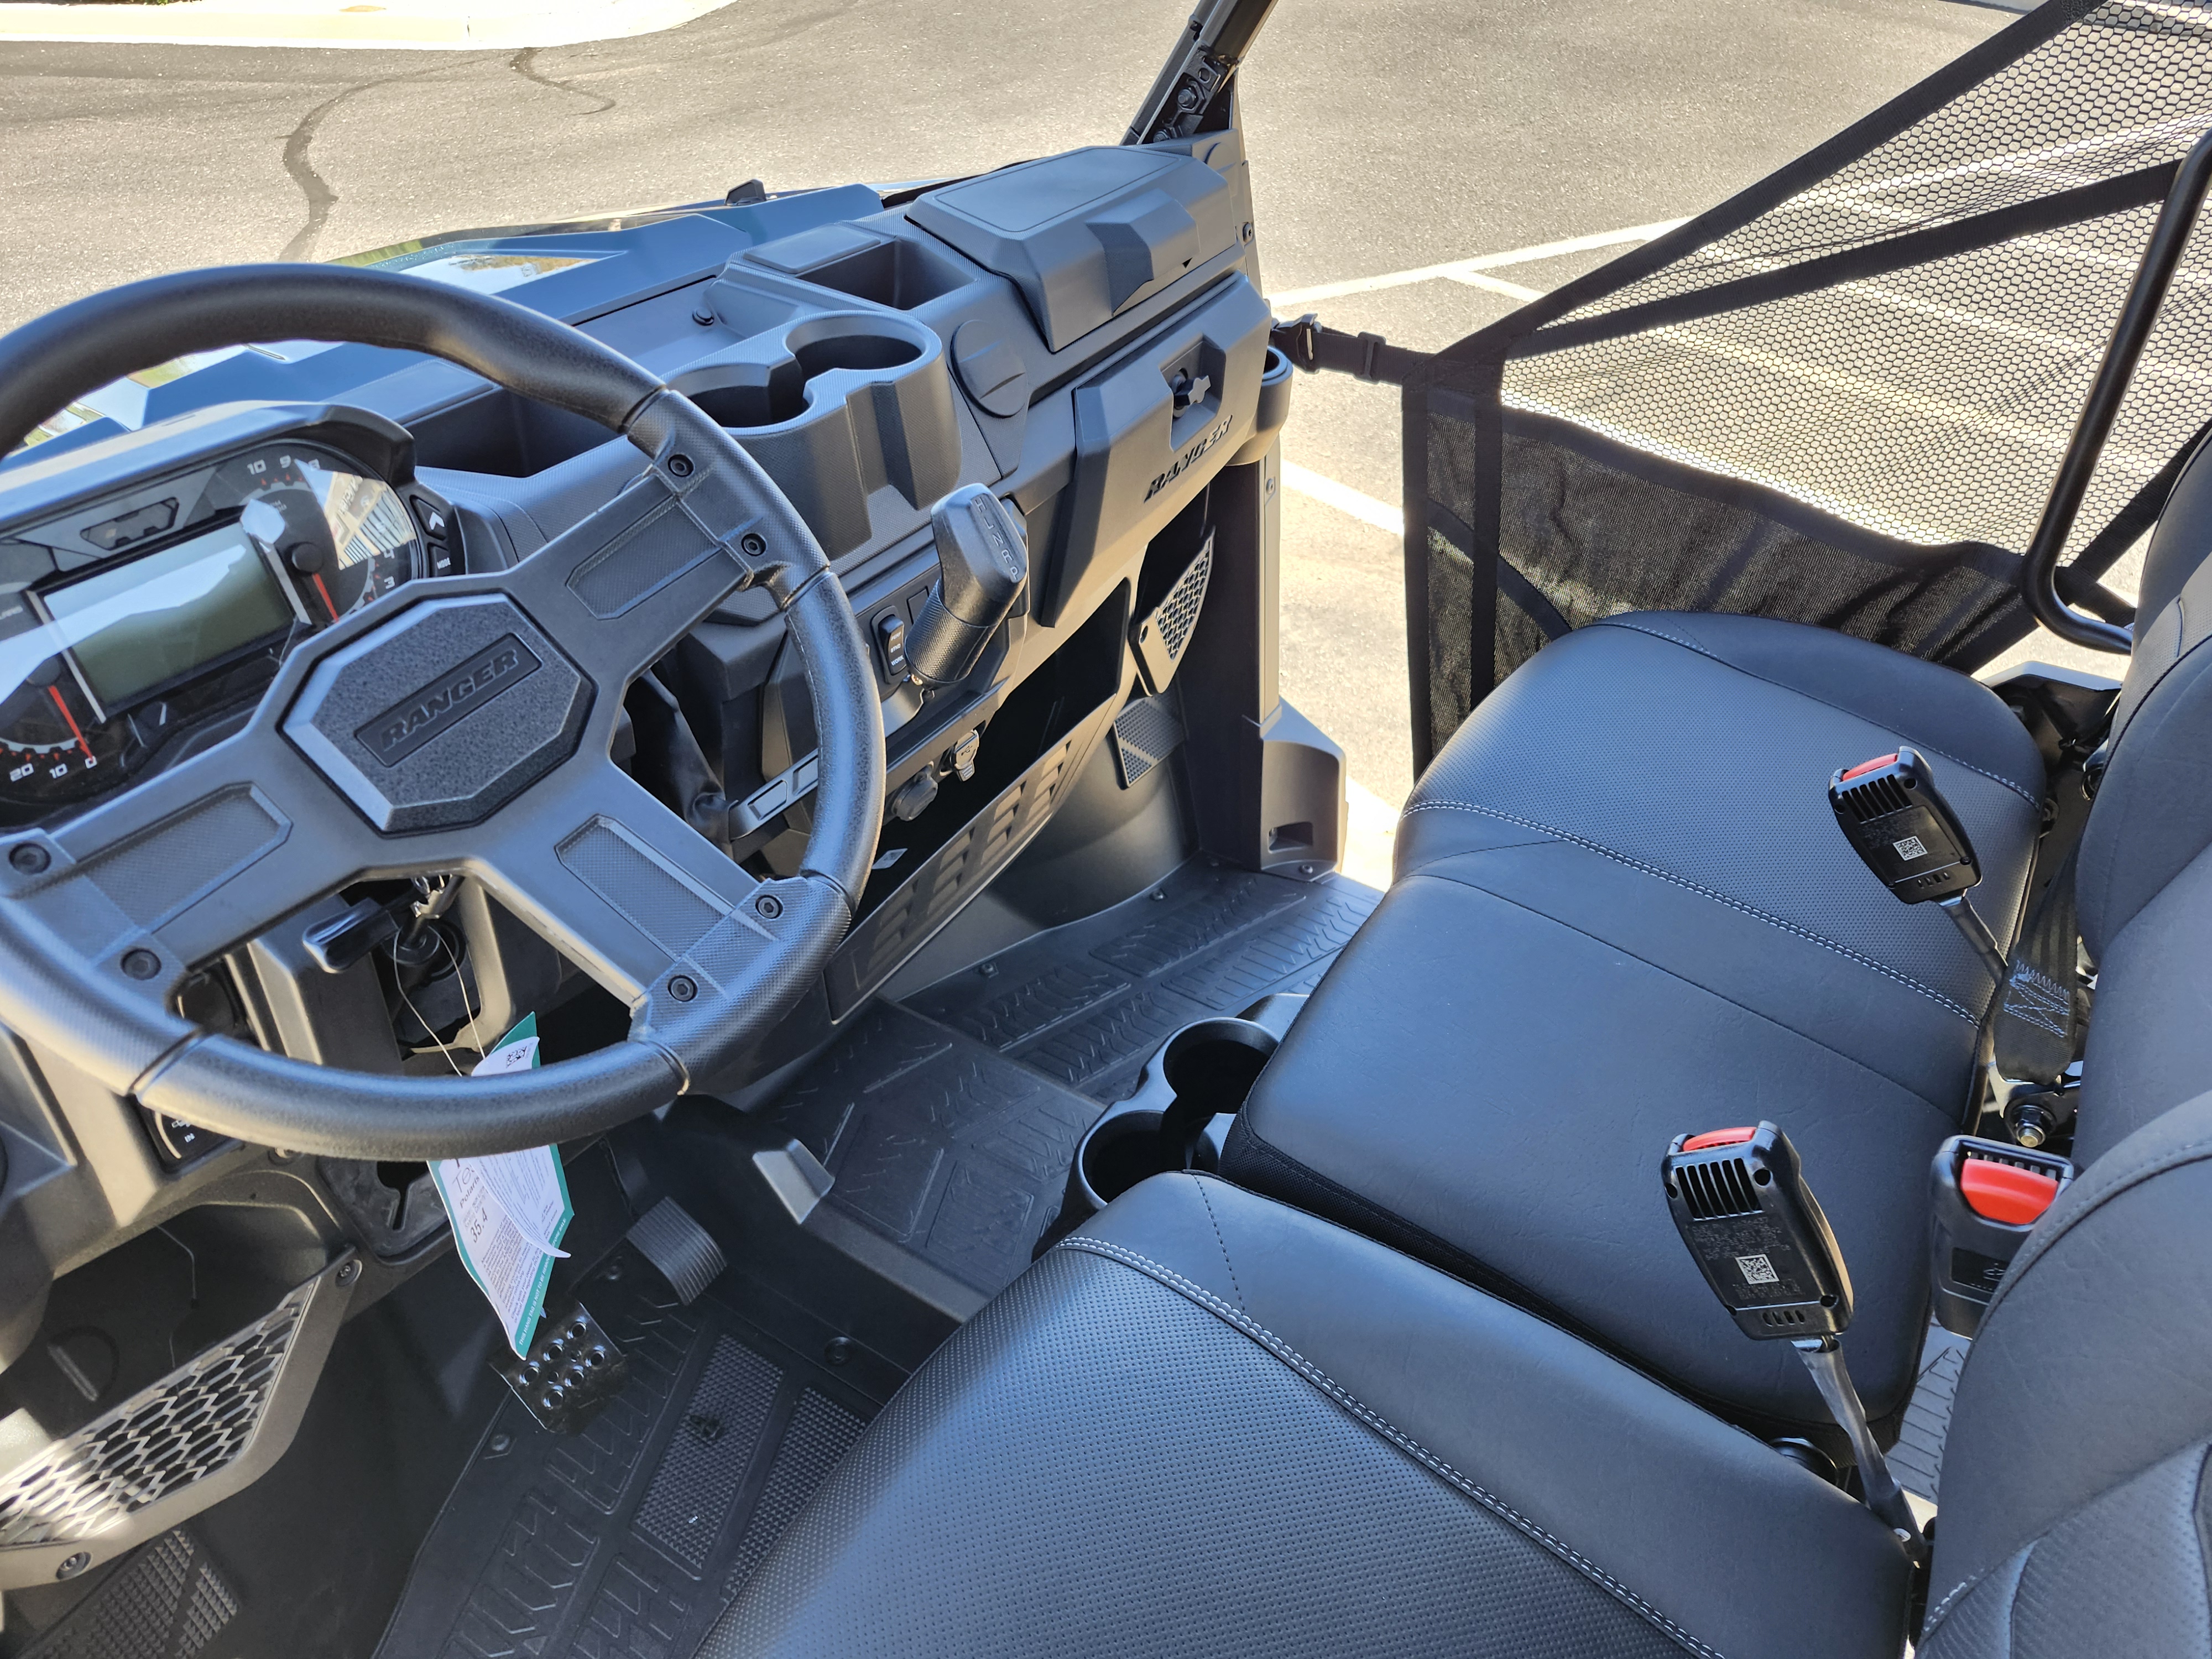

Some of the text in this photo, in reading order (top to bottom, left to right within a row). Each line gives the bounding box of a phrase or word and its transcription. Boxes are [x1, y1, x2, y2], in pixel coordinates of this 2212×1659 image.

[247, 459, 267, 475] 10
[279, 455, 291, 468] 9
[1144, 415, 1233, 504] RANGER
[975, 497, 987, 513] H
[984, 517, 994, 530] L
[992, 532, 1004, 546] N
[437, 556, 451, 570] MODE
[1001, 549, 1014, 564] R
[1010, 566, 1019, 580] P
[384, 576, 395, 589] 3
[891, 655, 904, 666] WORK
[380, 649, 518, 752] RANGER
[49, 763, 67, 779] 10
[460, 1176, 479, 1209] Polaris
[470, 1207, 488, 1244] 35.4
[523, 1316, 531, 1333] HANG
[551, 1230, 560, 1246] EFORE
